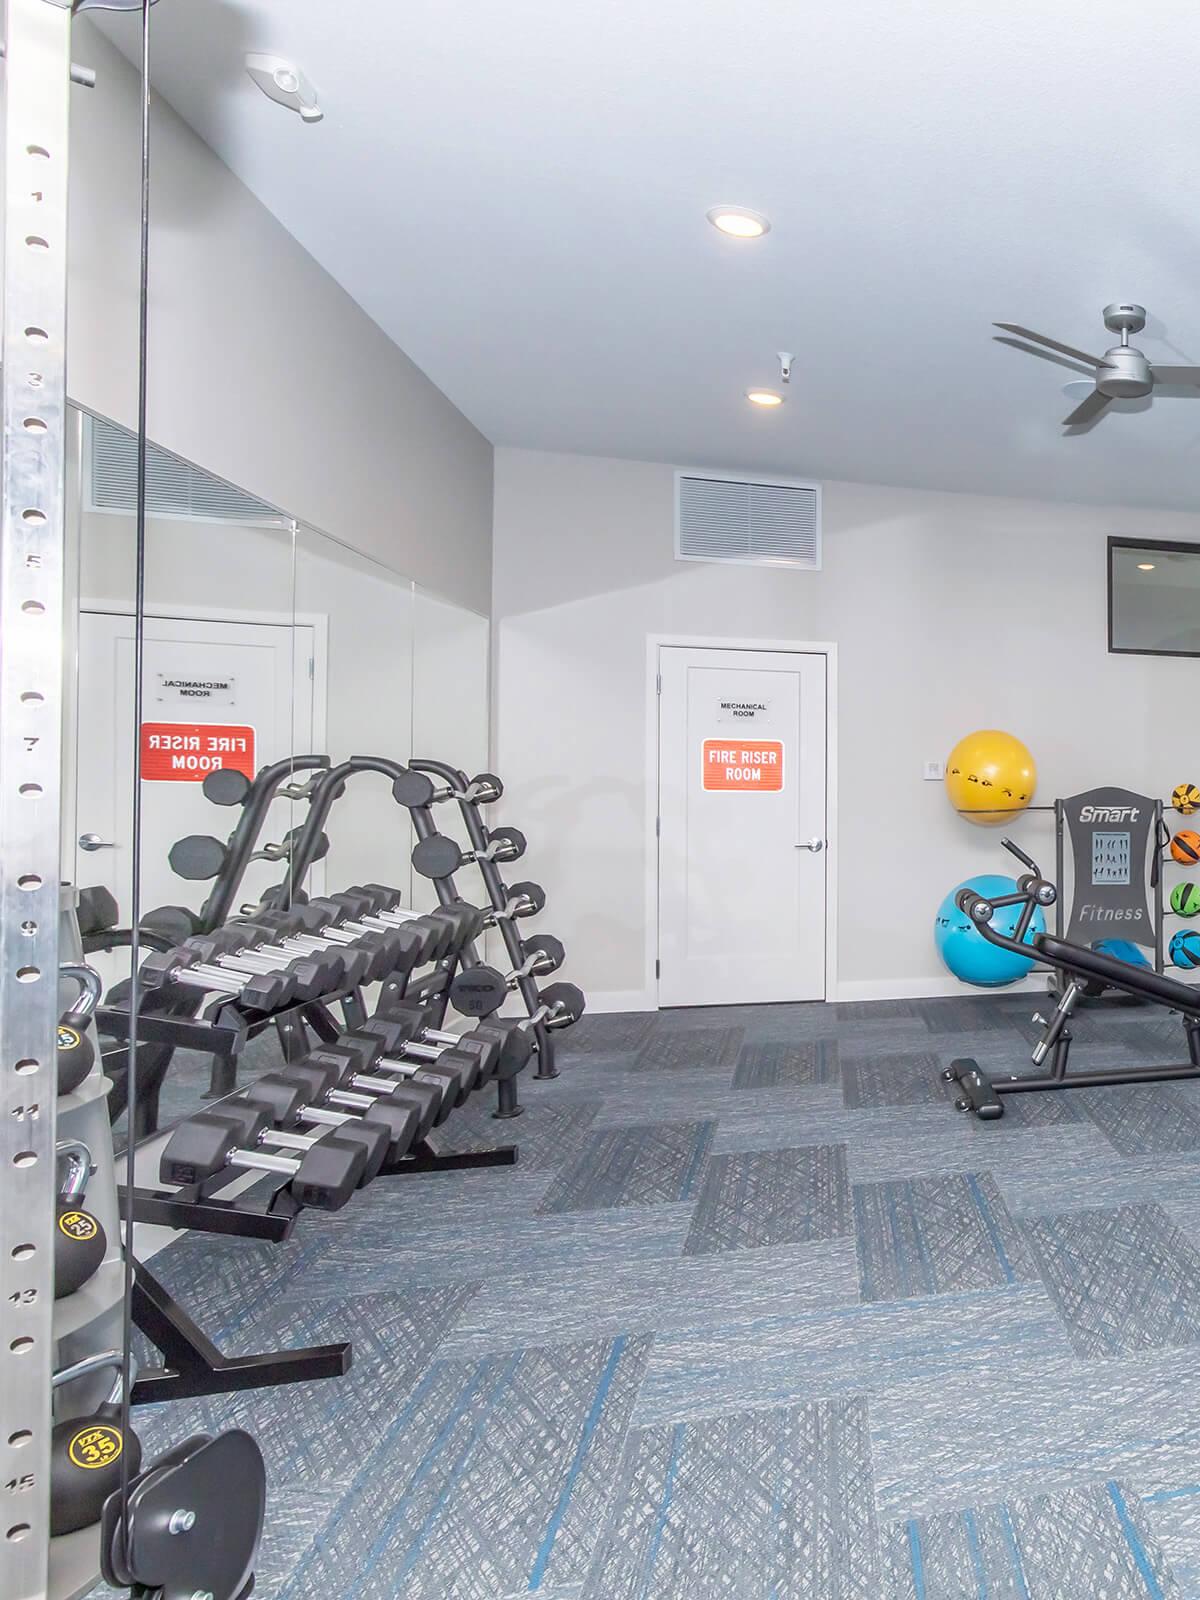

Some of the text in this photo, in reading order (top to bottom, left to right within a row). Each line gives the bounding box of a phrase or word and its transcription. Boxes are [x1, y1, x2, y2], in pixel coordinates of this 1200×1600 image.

[28, 372, 43, 388] 3
[27, 554, 42, 569] 5
[720, 703, 767, 711] MECHANICAL
[23, 737, 40, 752] 7
[709, 750, 777, 764] FIRE RISER
[725, 767, 761, 781] ROOM
[1080, 806, 1140, 823] Smart
[1080, 904, 1143, 921] Fitness
[20, 920, 38, 937] 9
[11, 1103, 39, 1121] 11
[70, 1219, 92, 1236] 25
[8, 1288, 38, 1308] 13
[78, 1430, 105, 1448] VTX
[81, 1437, 116, 1462] 35
[4, 1473, 35, 1496] 15
